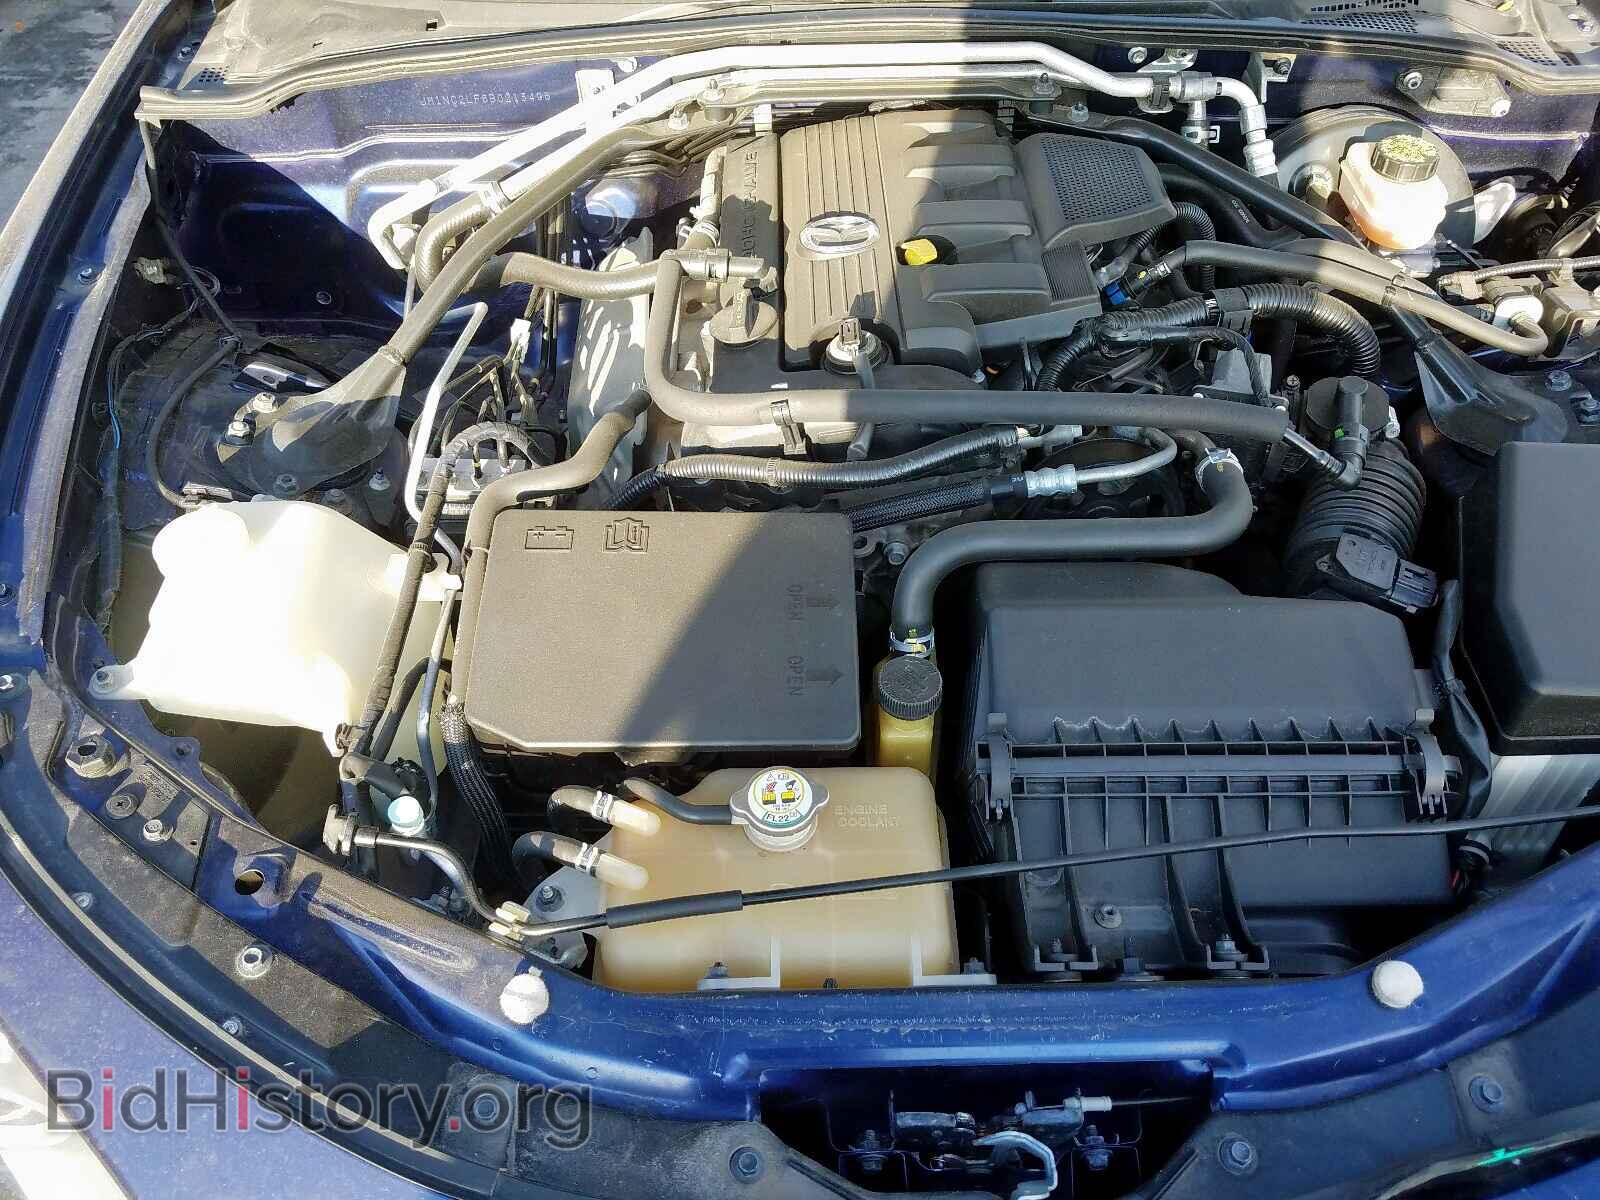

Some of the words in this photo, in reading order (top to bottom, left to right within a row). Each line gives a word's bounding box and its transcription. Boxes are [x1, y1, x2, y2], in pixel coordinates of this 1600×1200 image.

[785, 584, 804, 622] OPEN
[785, 656, 804, 696] OPEN
[766, 813, 790, 823] FL22
[833, 804, 888, 816] ENGINE
